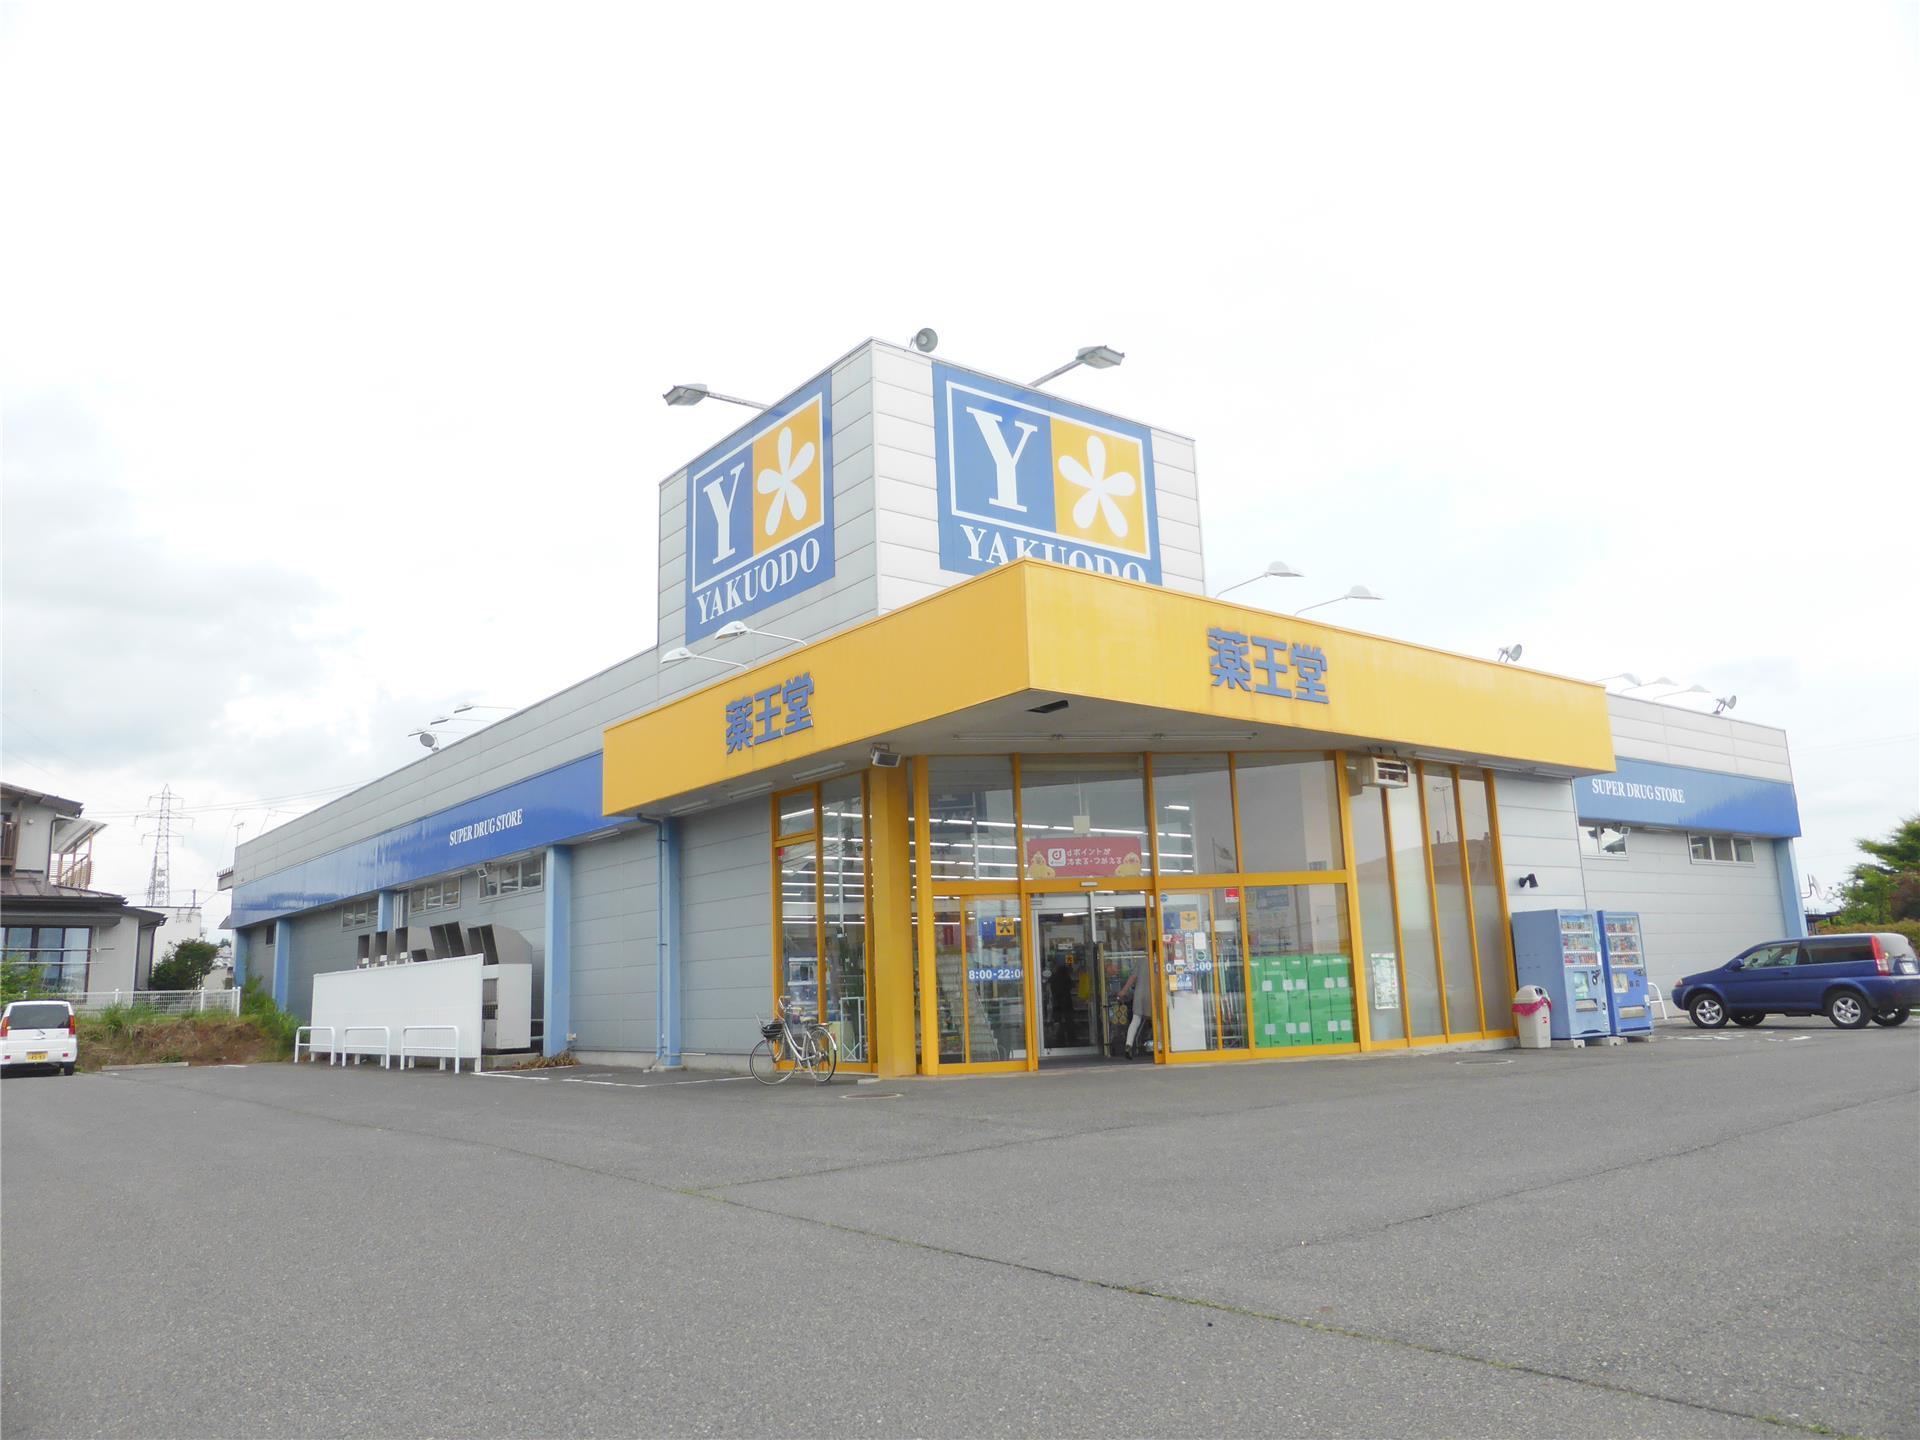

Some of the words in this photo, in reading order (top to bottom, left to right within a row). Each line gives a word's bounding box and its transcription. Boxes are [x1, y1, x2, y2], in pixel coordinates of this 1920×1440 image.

[966, 406, 1038, 513] Y
[702, 462, 745, 565] Y
[696, 538, 820, 625] YAKUODO
[1207, 627, 1330, 705] 薬王堂
[725, 671, 815, 756] 薬王堂
[449, 825, 473, 846] SUPER
[473, 817, 496, 839] DRUG
[496, 808, 523, 832] STORE
[1591, 778, 1626, 797] SUPER
[1626, 782, 1654, 800] DRUG
[1655, 786, 1686, 804] STORE
